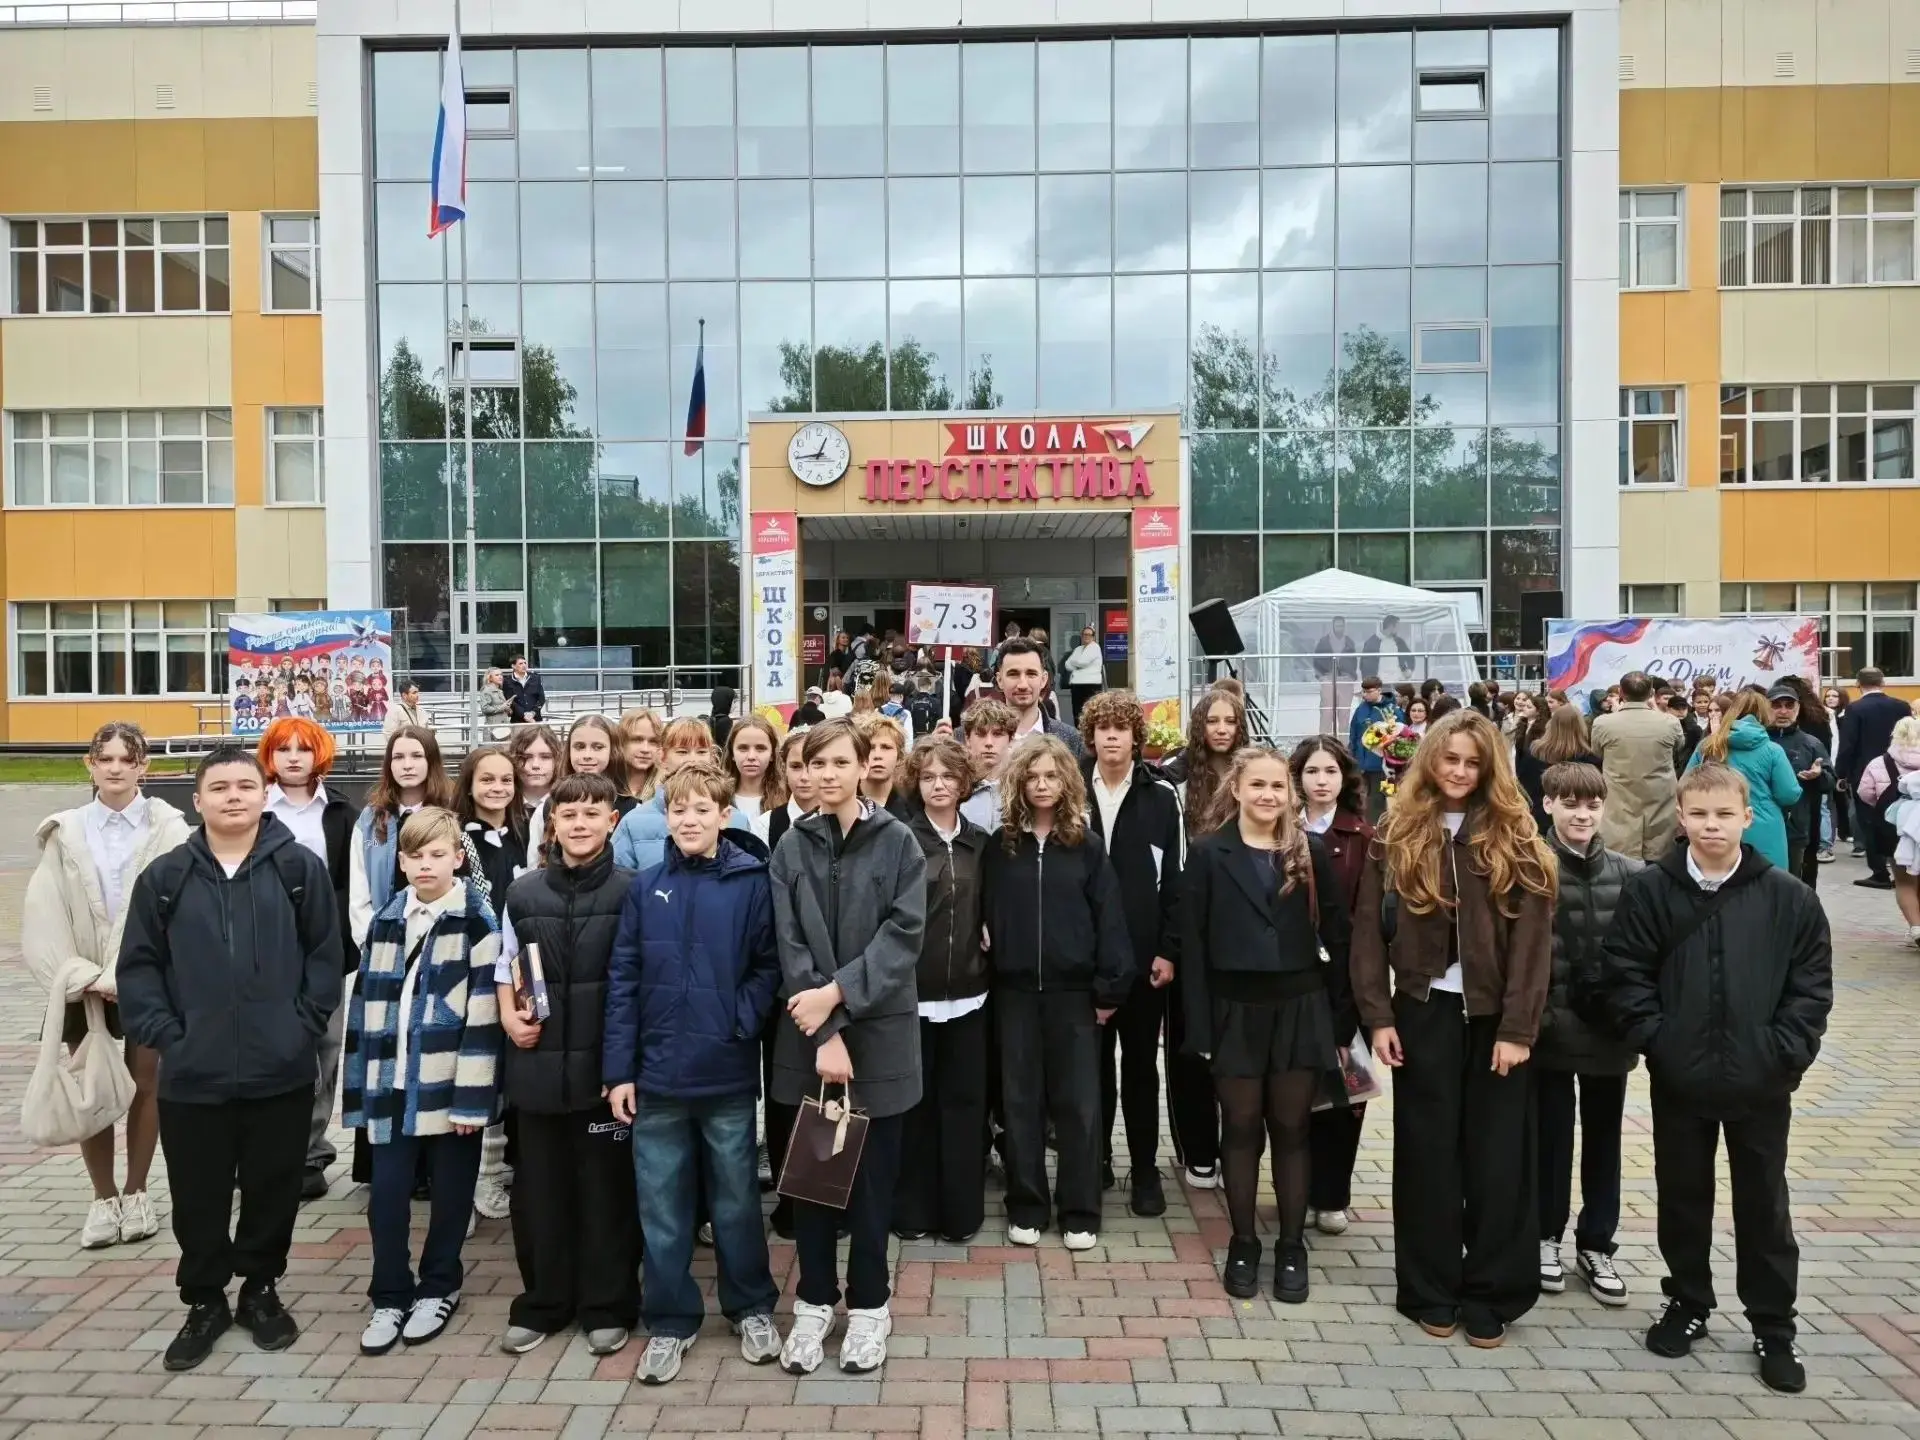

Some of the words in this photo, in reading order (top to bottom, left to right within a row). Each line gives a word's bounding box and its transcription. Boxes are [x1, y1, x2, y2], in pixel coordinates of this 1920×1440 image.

[966, 424, 1087, 450] ШКОЛА
[866, 456, 1152, 501] ПЕРСПЕКТИВА
[1139, 584, 1148, 595] С
[1151, 562, 1170, 595] 1
[933, 603, 977, 630] 7.3
[763, 587, 787, 687] ШКОЛА
[803, 638, 817, 648] УЗЕЙ
[1661, 645, 1722, 655] СЕНТЯБРЯ
[1644, 659, 1663, 676] С
[1669, 658, 1734, 680] Днём
